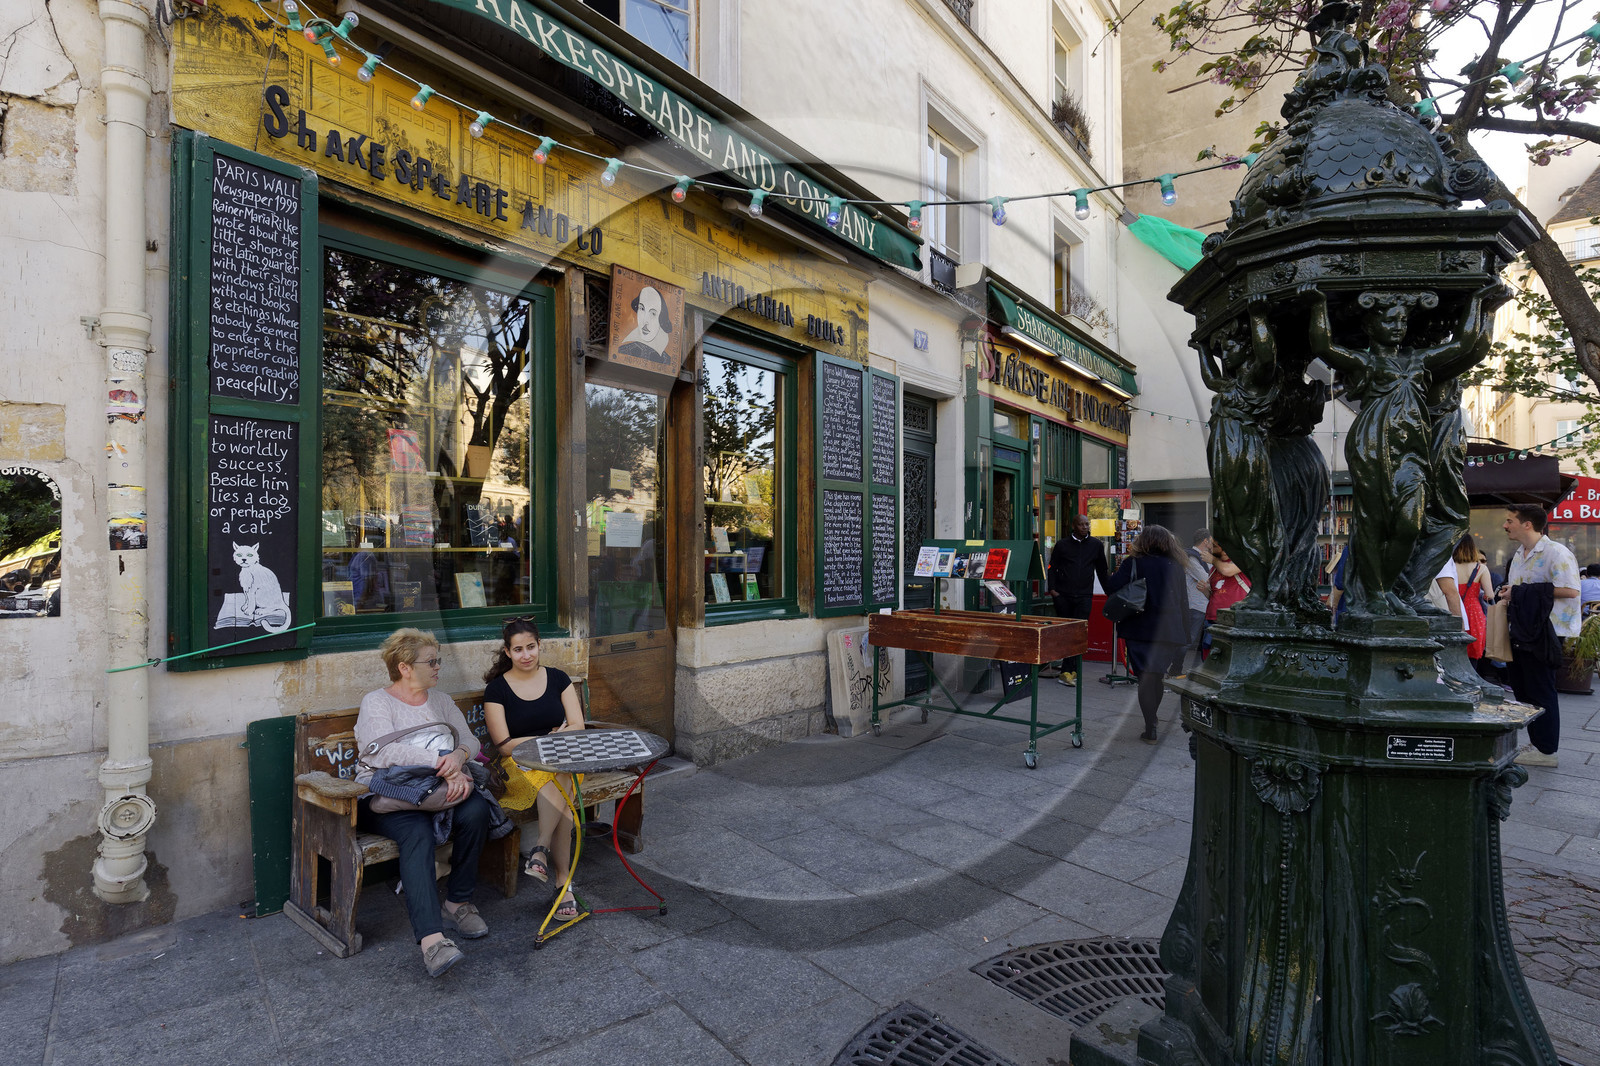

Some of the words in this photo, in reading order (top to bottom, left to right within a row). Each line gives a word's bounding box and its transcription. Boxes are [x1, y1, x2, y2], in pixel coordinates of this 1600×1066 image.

[217, 159, 259, 186] PARIS
[263, 175, 298, 200] WALL
[722, 134, 776, 191] AND
[784, 169, 876, 250] COMANY
[214, 177, 273, 209] Newspaper
[275, 195, 297, 215] 1999
[213, 199, 244, 216] Rainer
[244, 207, 270, 225] Maria
[272, 213, 298, 235] Rilke
[521, 201, 569, 243] AND
[213, 215, 245, 231] wrote
[249, 225, 278, 242] about
[282, 234, 298, 250] the
[213, 241, 233, 256] the
[262, 257, 299, 274] quarter
[250, 239, 282, 258] shops
[285, 250, 297, 266] of
[213, 257, 237, 271] with
[242, 260, 269, 280] their
[272, 272, 298, 291] shop
[213, 271, 264, 291] windows
[268, 283, 298, 303] filled
[212, 284, 237, 299] with
[239, 289, 257, 303] old
[261, 293, 290, 312] books
[702, 271, 795, 328] ANTIQUARIAN
[807, 313, 846, 346] BOOKS
[213, 297, 222, 310] &
[273, 312, 299, 329] Where
[212, 314, 251, 333] nobody
[255, 324, 298, 342] seemed
[213, 327, 224, 338] to
[228, 330, 260, 346] enter
[264, 336, 271, 350] &
[276, 339, 296, 354] the
[1016, 305, 1077, 362] SHAKESPEARE
[1078, 345, 1093, 371] AND
[213, 343, 270, 361] proprietor
[272, 355, 298, 368] could
[214, 356, 228, 370] be
[232, 362, 258, 374] seen
[261, 367, 298, 389] reading
[216, 376, 292, 401] peacefully,
[215, 420, 293, 440] indifferent
[212, 438, 226, 453] to
[230, 441, 288, 462] worldly
[218, 458, 287, 475] success.
[210, 472, 258, 486] Beside
[263, 473, 288, 490] him
[210, 508, 225, 517] or
[231, 505, 282, 523] perhaps
[213, 487, 239, 502] lies
[245, 493, 253, 504] a
[259, 491, 291, 513] dog
[1553, 507, 1573, 519] La
[1580, 504, 1600, 519] Bu
[222, 522, 230, 534] a
[238, 520, 272, 535] cat.
